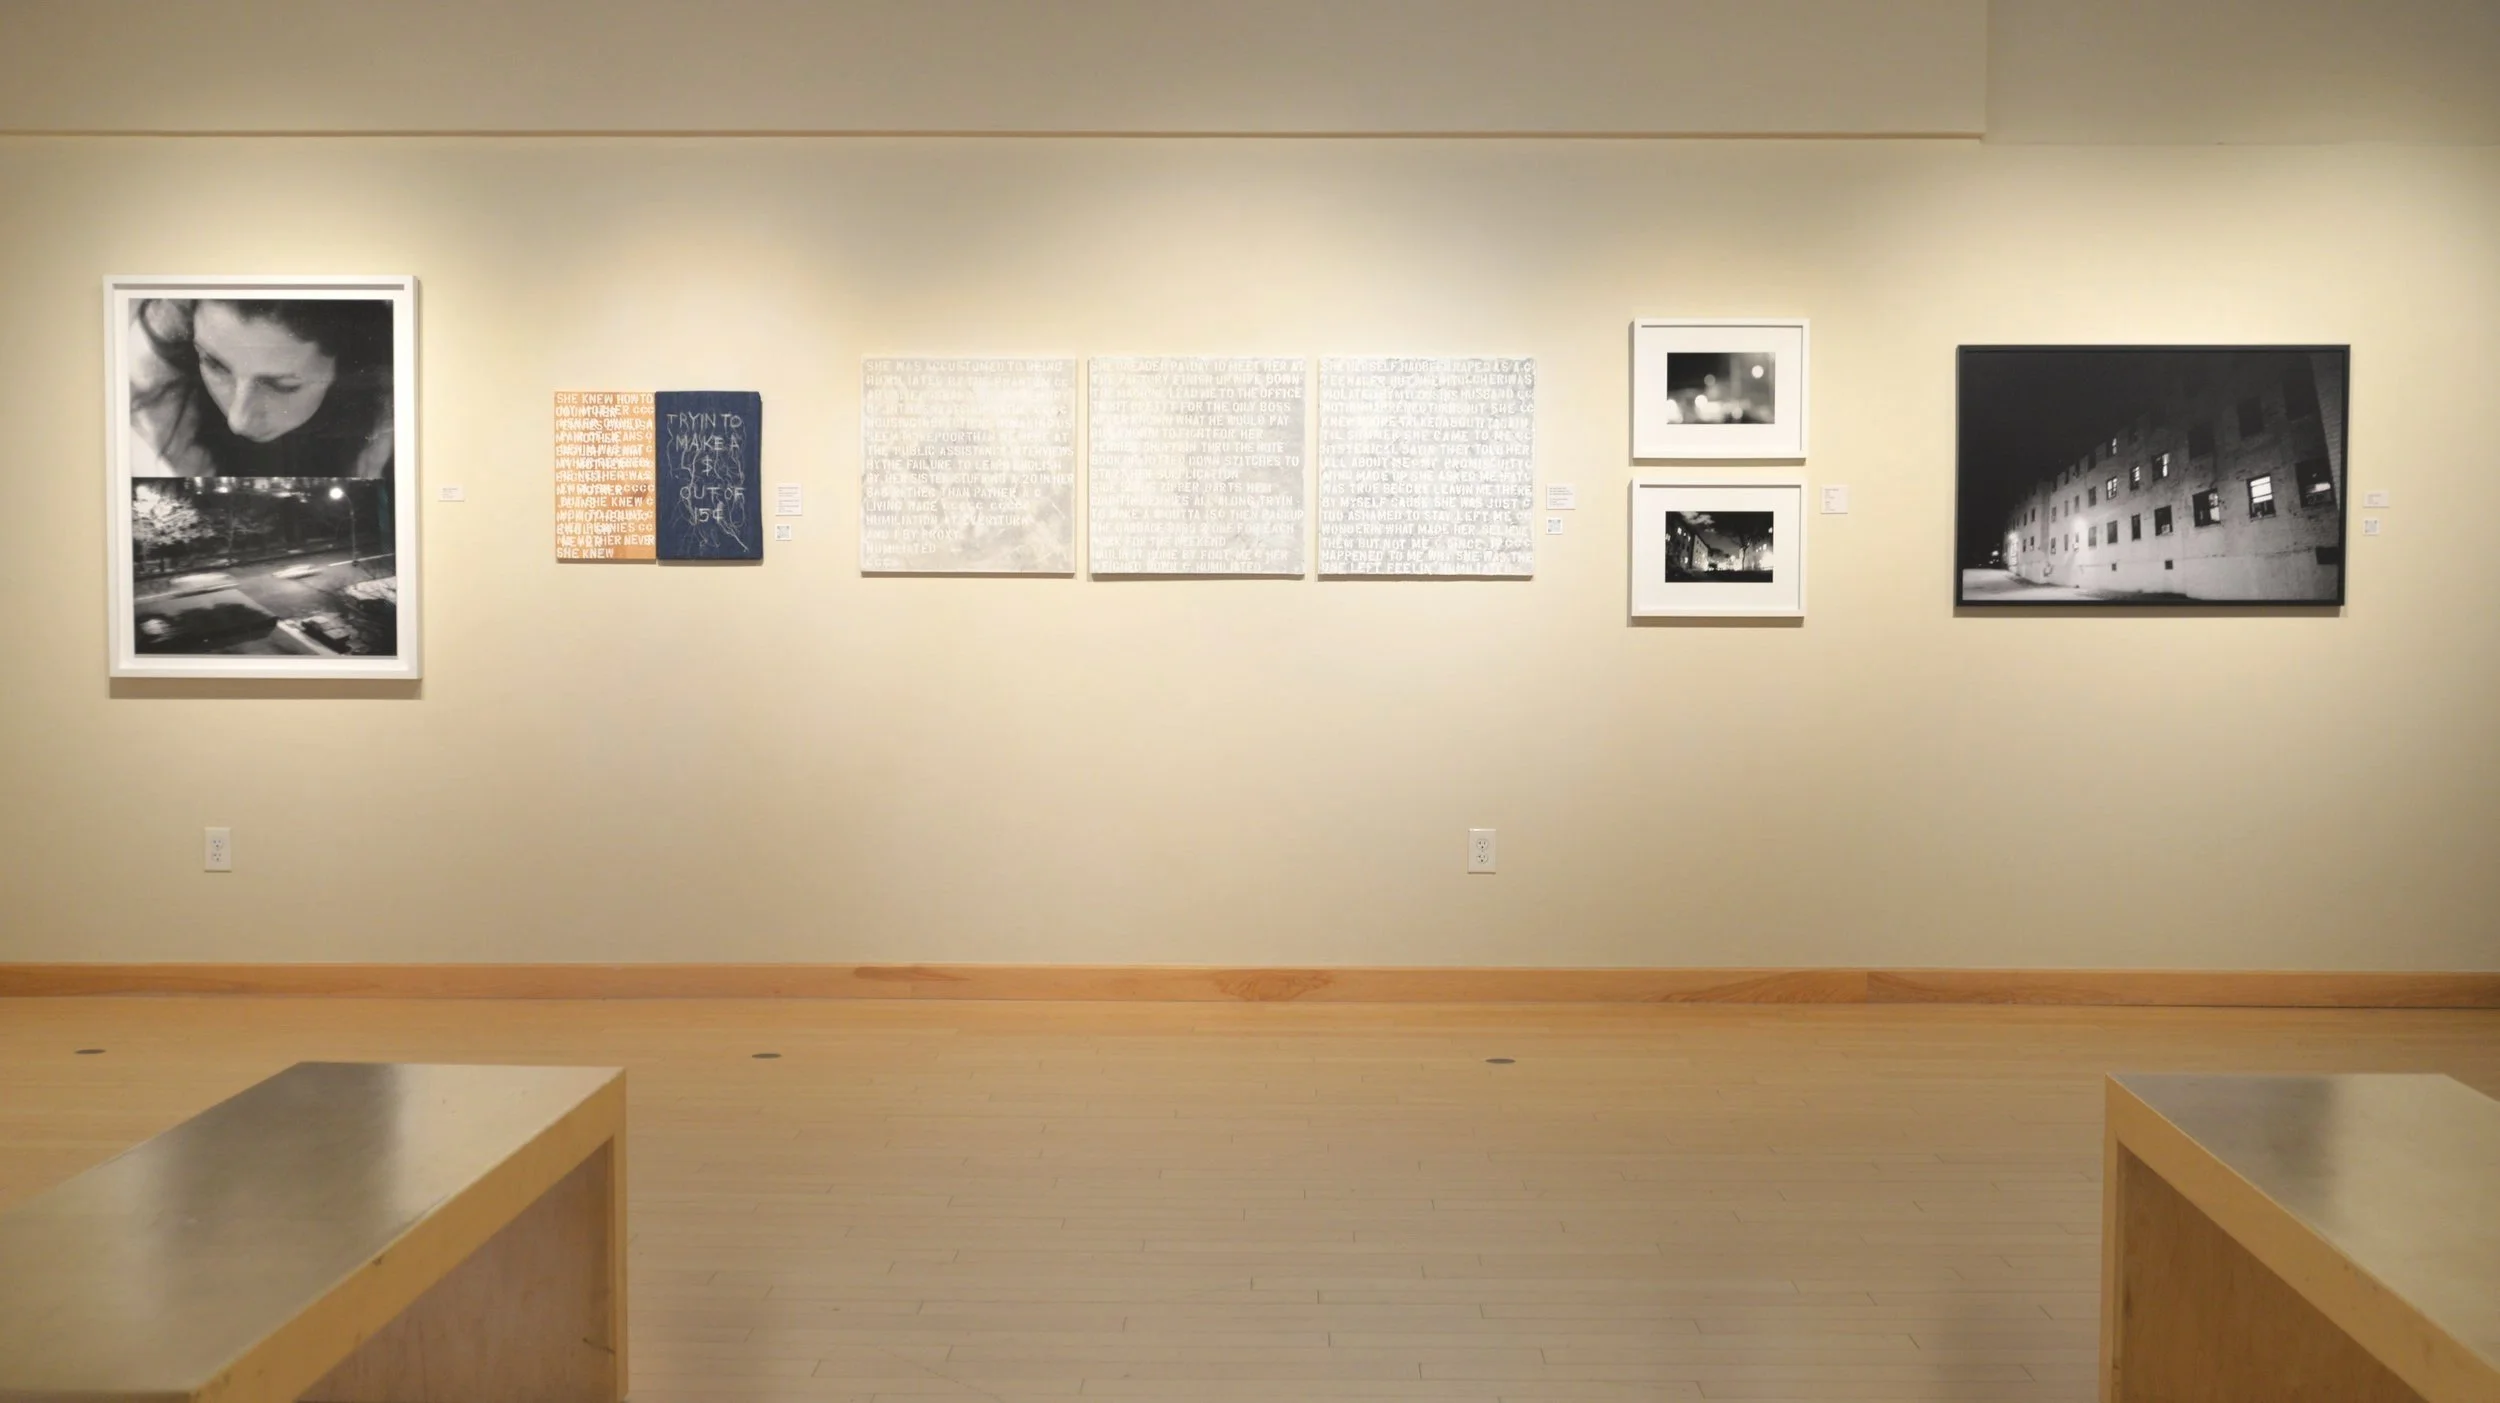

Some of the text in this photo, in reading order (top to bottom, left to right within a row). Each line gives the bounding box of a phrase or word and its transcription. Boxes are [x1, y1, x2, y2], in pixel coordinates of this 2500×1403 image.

[557, 393, 578, 405] SHE
[582, 393, 614, 405] KNEW
[640, 393, 655, 405] TO
